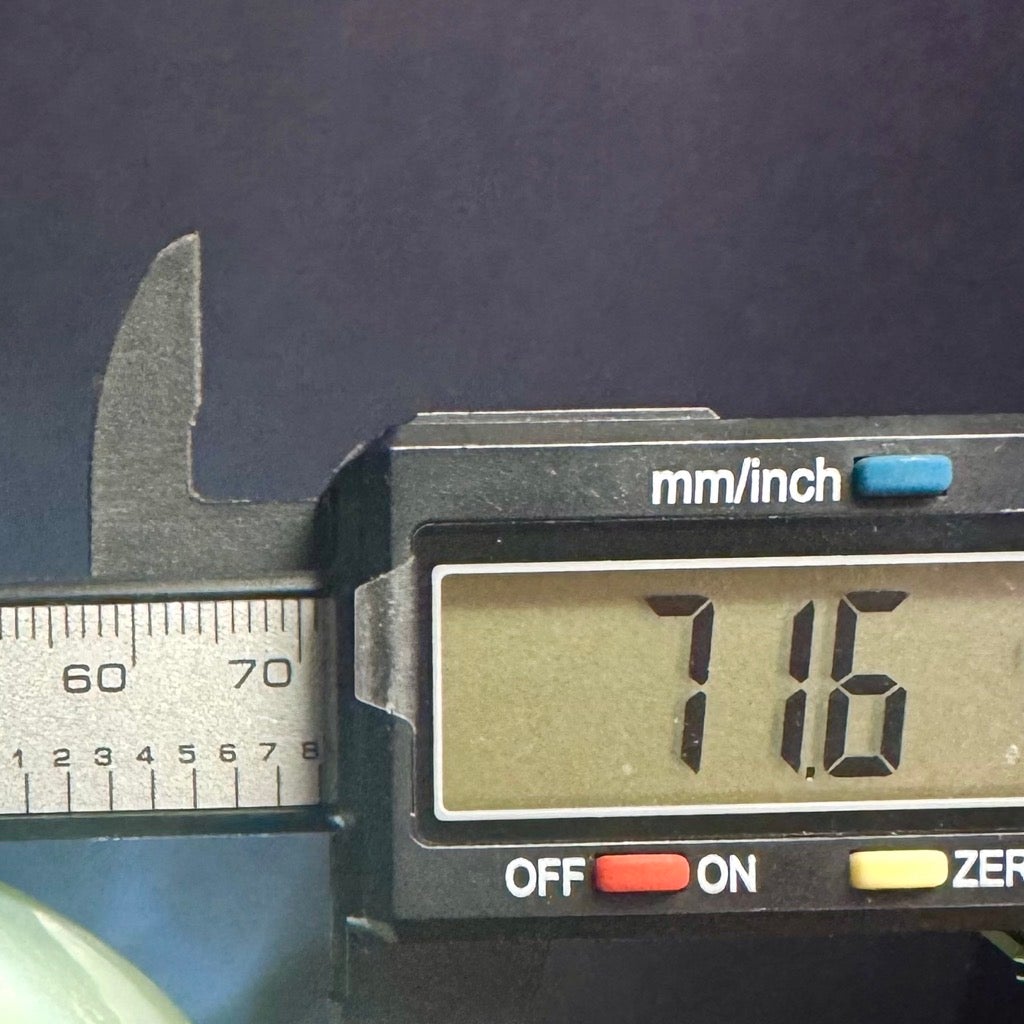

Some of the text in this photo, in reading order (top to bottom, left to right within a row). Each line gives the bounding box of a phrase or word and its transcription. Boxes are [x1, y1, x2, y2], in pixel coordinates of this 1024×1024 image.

[651, 456, 841, 505] mm/inch
[63, 663, 126, 693] 60
[228, 658, 292, 688] 70
[12, 749, 23, 768] 1
[53, 748, 71, 767] 2
[94, 747, 112, 766] 3
[136, 746, 154, 764] 4
[178, 745, 196, 764] 5
[219, 744, 237, 762] 6
[259, 743, 276, 761] 7
[302, 742, 319, 760] 8
[505, 849, 1024, 897] OFF ON ZER
